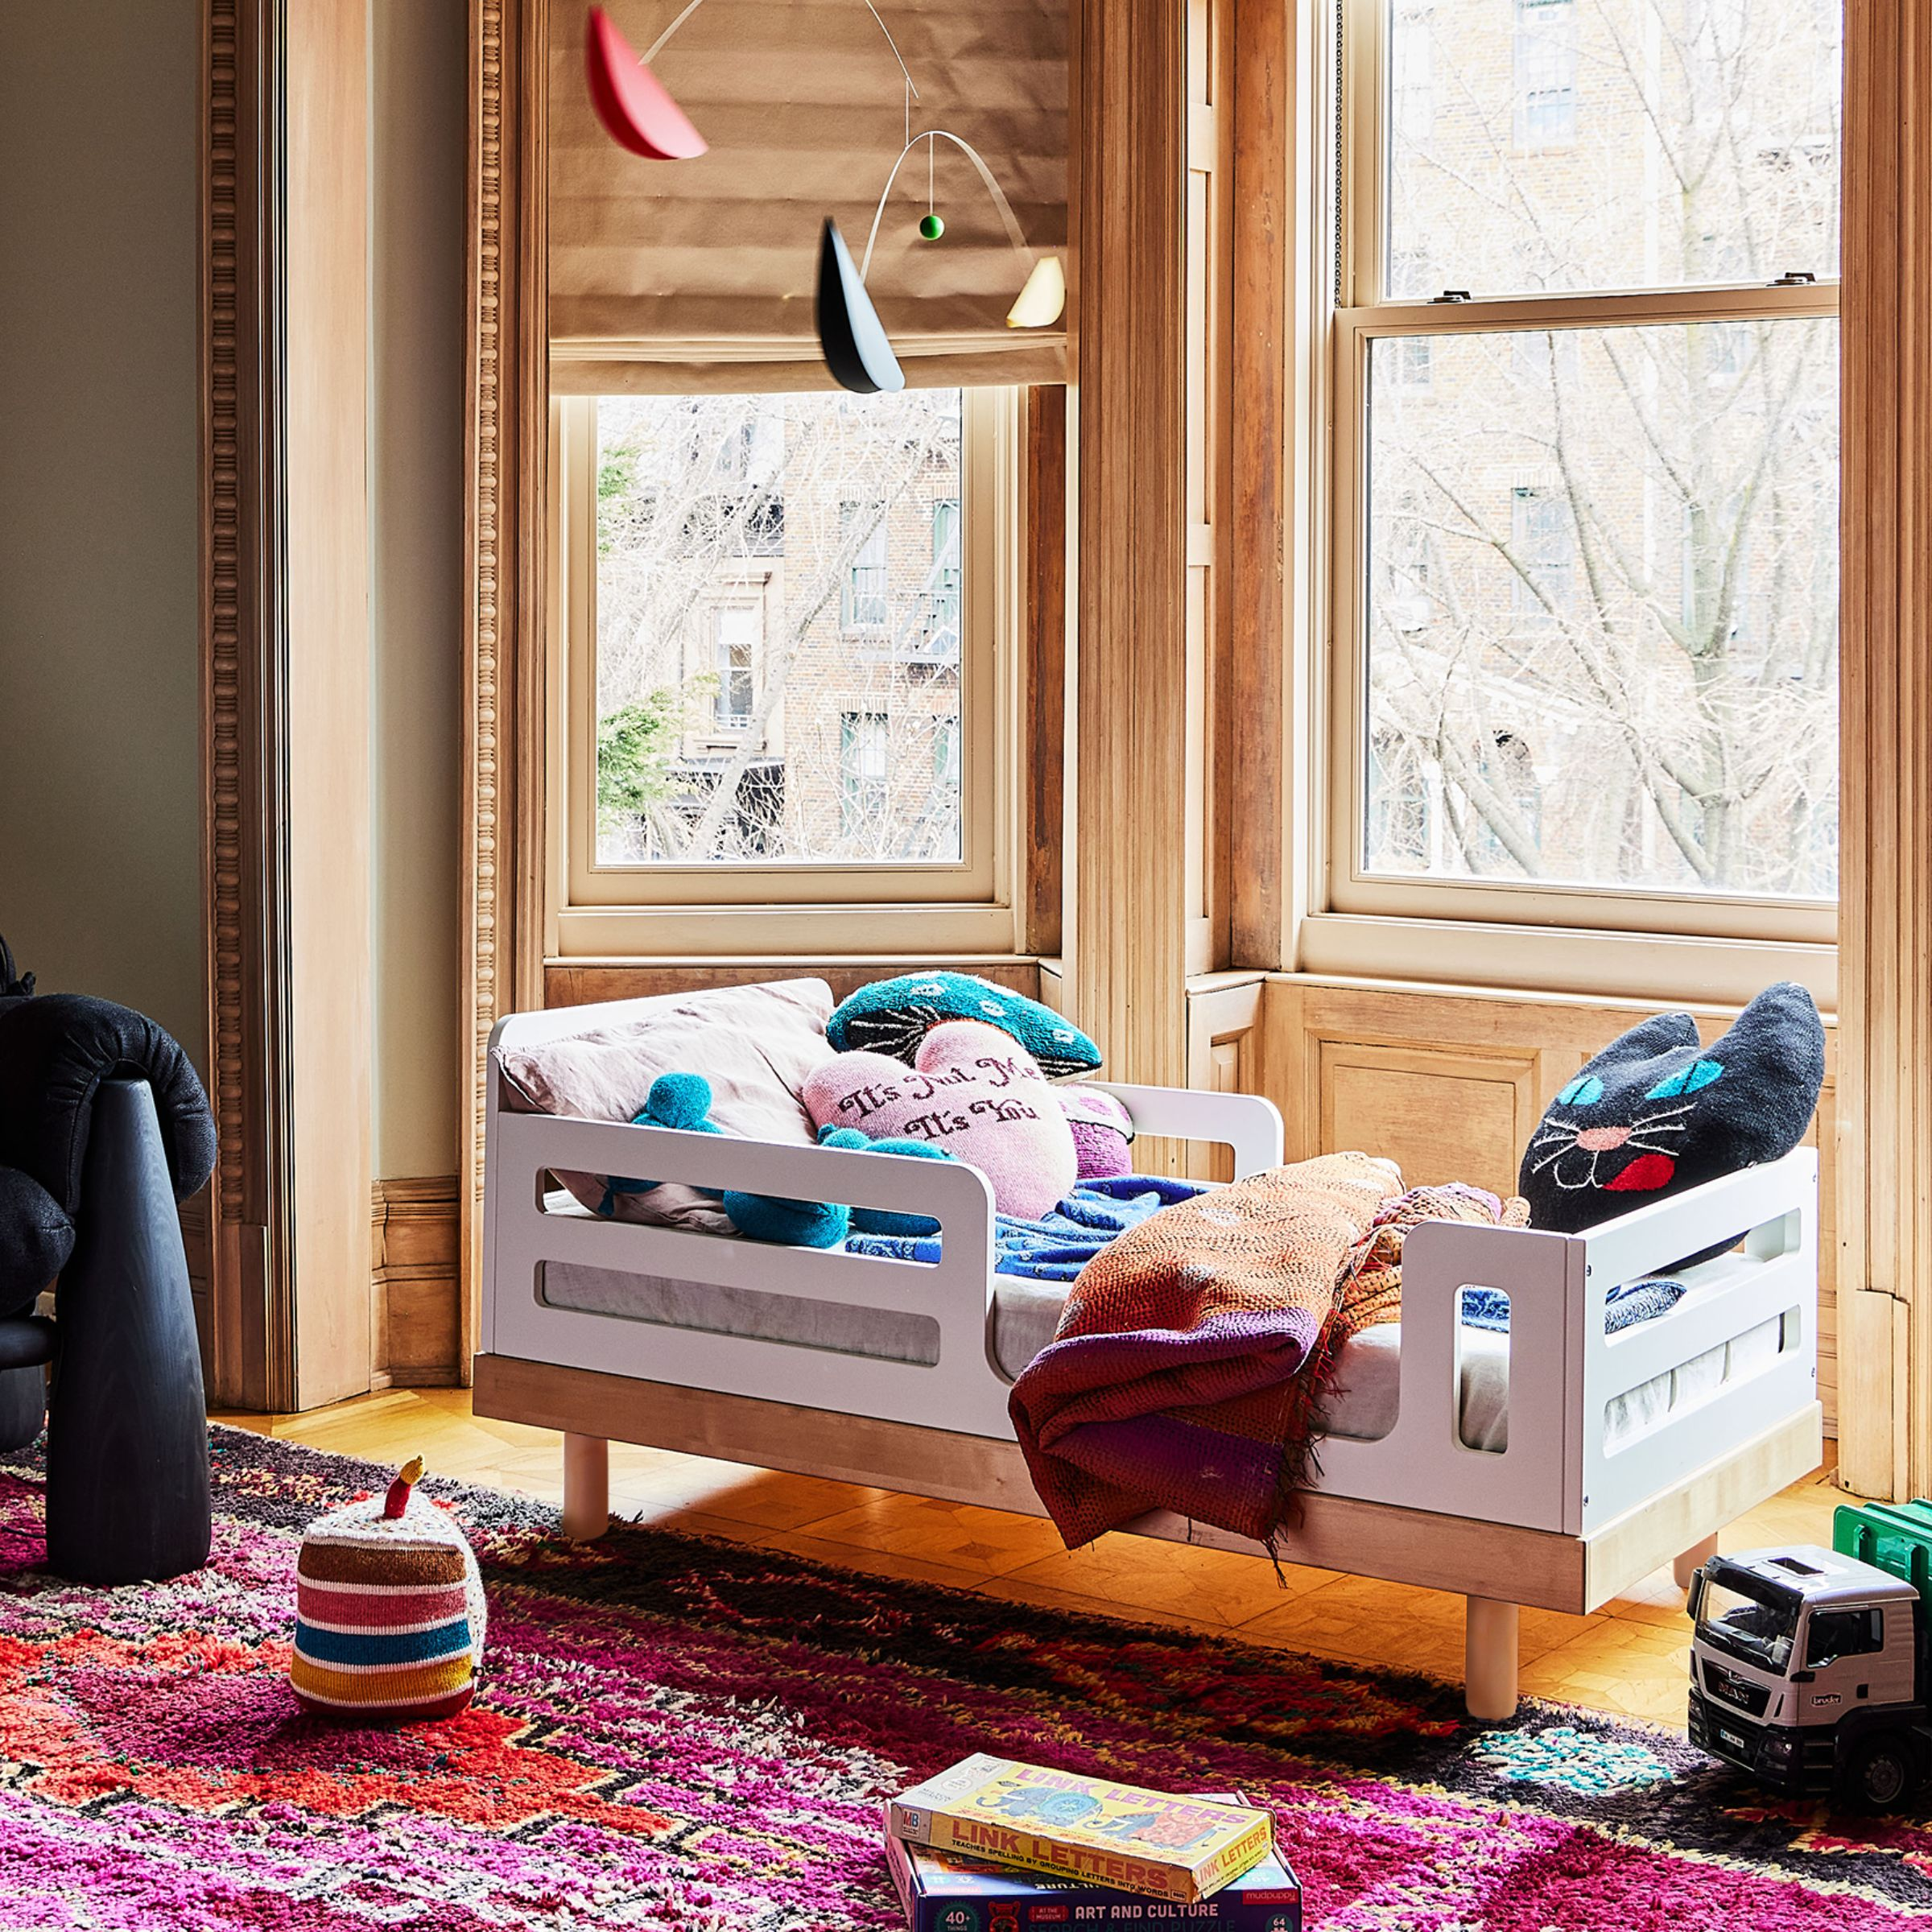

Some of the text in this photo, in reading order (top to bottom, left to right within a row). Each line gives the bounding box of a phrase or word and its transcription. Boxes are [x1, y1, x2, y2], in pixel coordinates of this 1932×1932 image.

[838, 1056, 1040, 1119] It's Not Me
[903, 1099, 1040, 1141] It's You
[1718, 1682, 1749, 1704] MAN
[1813, 1696, 1840, 1705] bruder
[1016, 1769, 1100, 1794] LINK
[1104, 1789, 1249, 1824] LETTERS
[903, 1811, 919, 1828] MB
[952, 1820, 1020, 1854] LINK
[1032, 1839, 1167, 1889] LETTERS
[1221, 1827, 1267, 1868] LETTERS
[952, 1839, 985, 1852] TEACHES
[989, 1848, 1024, 1862] SPELLING
[1039, 1860, 1079, 1876] GROUPING
[1082, 1872, 1115, 1885] LETTERS
[1117, 1880, 1135, 1889] INTO
[1138, 1885, 1168, 1897] WORDS
[1246, 1891, 1295, 1900] mudpuppy
[945, 1911, 971, 1924] 40+
[1075, 1904, 1219, 1919] ART AND CULTURE
[1171, 1920, 1235, 1931] PUZZLE
[1273, 1918, 1286, 1926] 64
